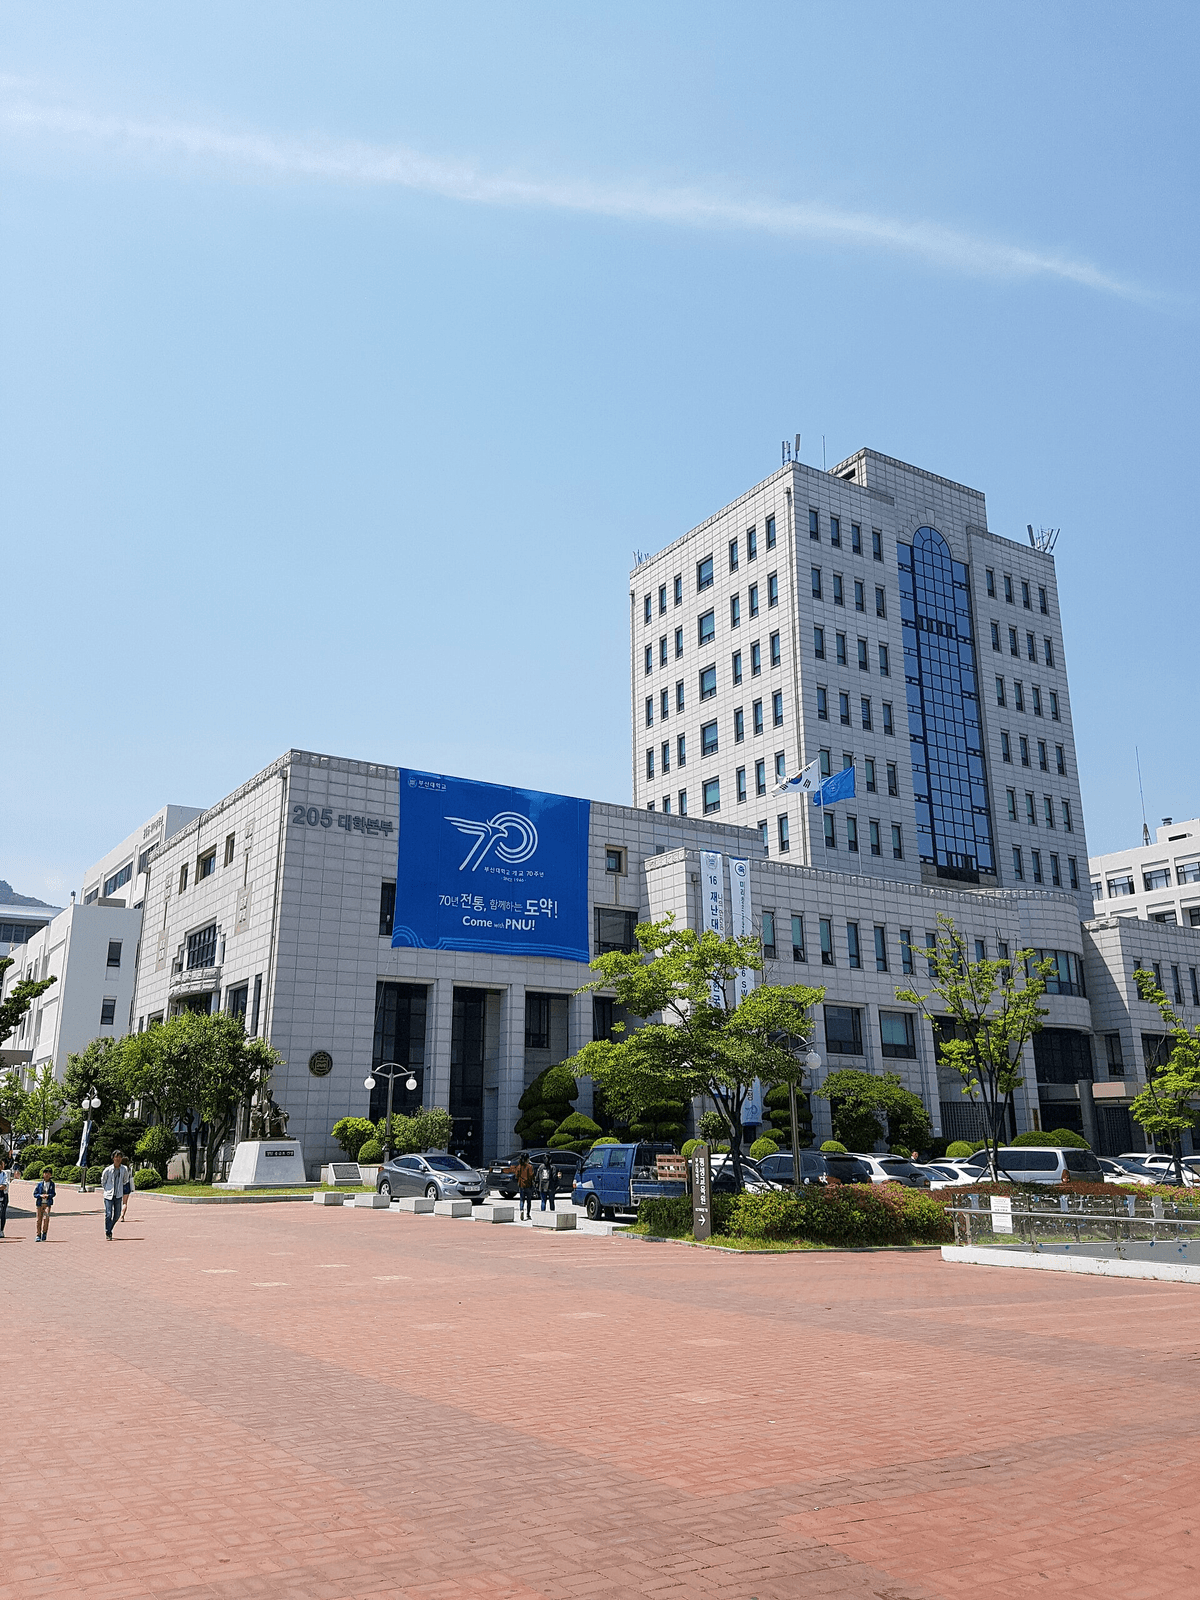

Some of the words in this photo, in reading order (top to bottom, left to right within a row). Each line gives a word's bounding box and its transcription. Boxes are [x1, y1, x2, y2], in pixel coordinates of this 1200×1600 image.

[292, 805, 333, 828] 205
[337, 814, 394, 837] 대학본부
[484, 866, 510, 876] 부산대학교
[526, 870, 545, 878] 70주년
[438, 895, 459, 907] 70년
[460, 893, 487, 912] 전통,
[489, 899, 523, 913] 함께하는
[524, 898, 558, 919] 도약!
[710, 891, 719, 934] 재난대
[462, 915, 492, 928] Come
[505, 918, 536, 931] PNU!
